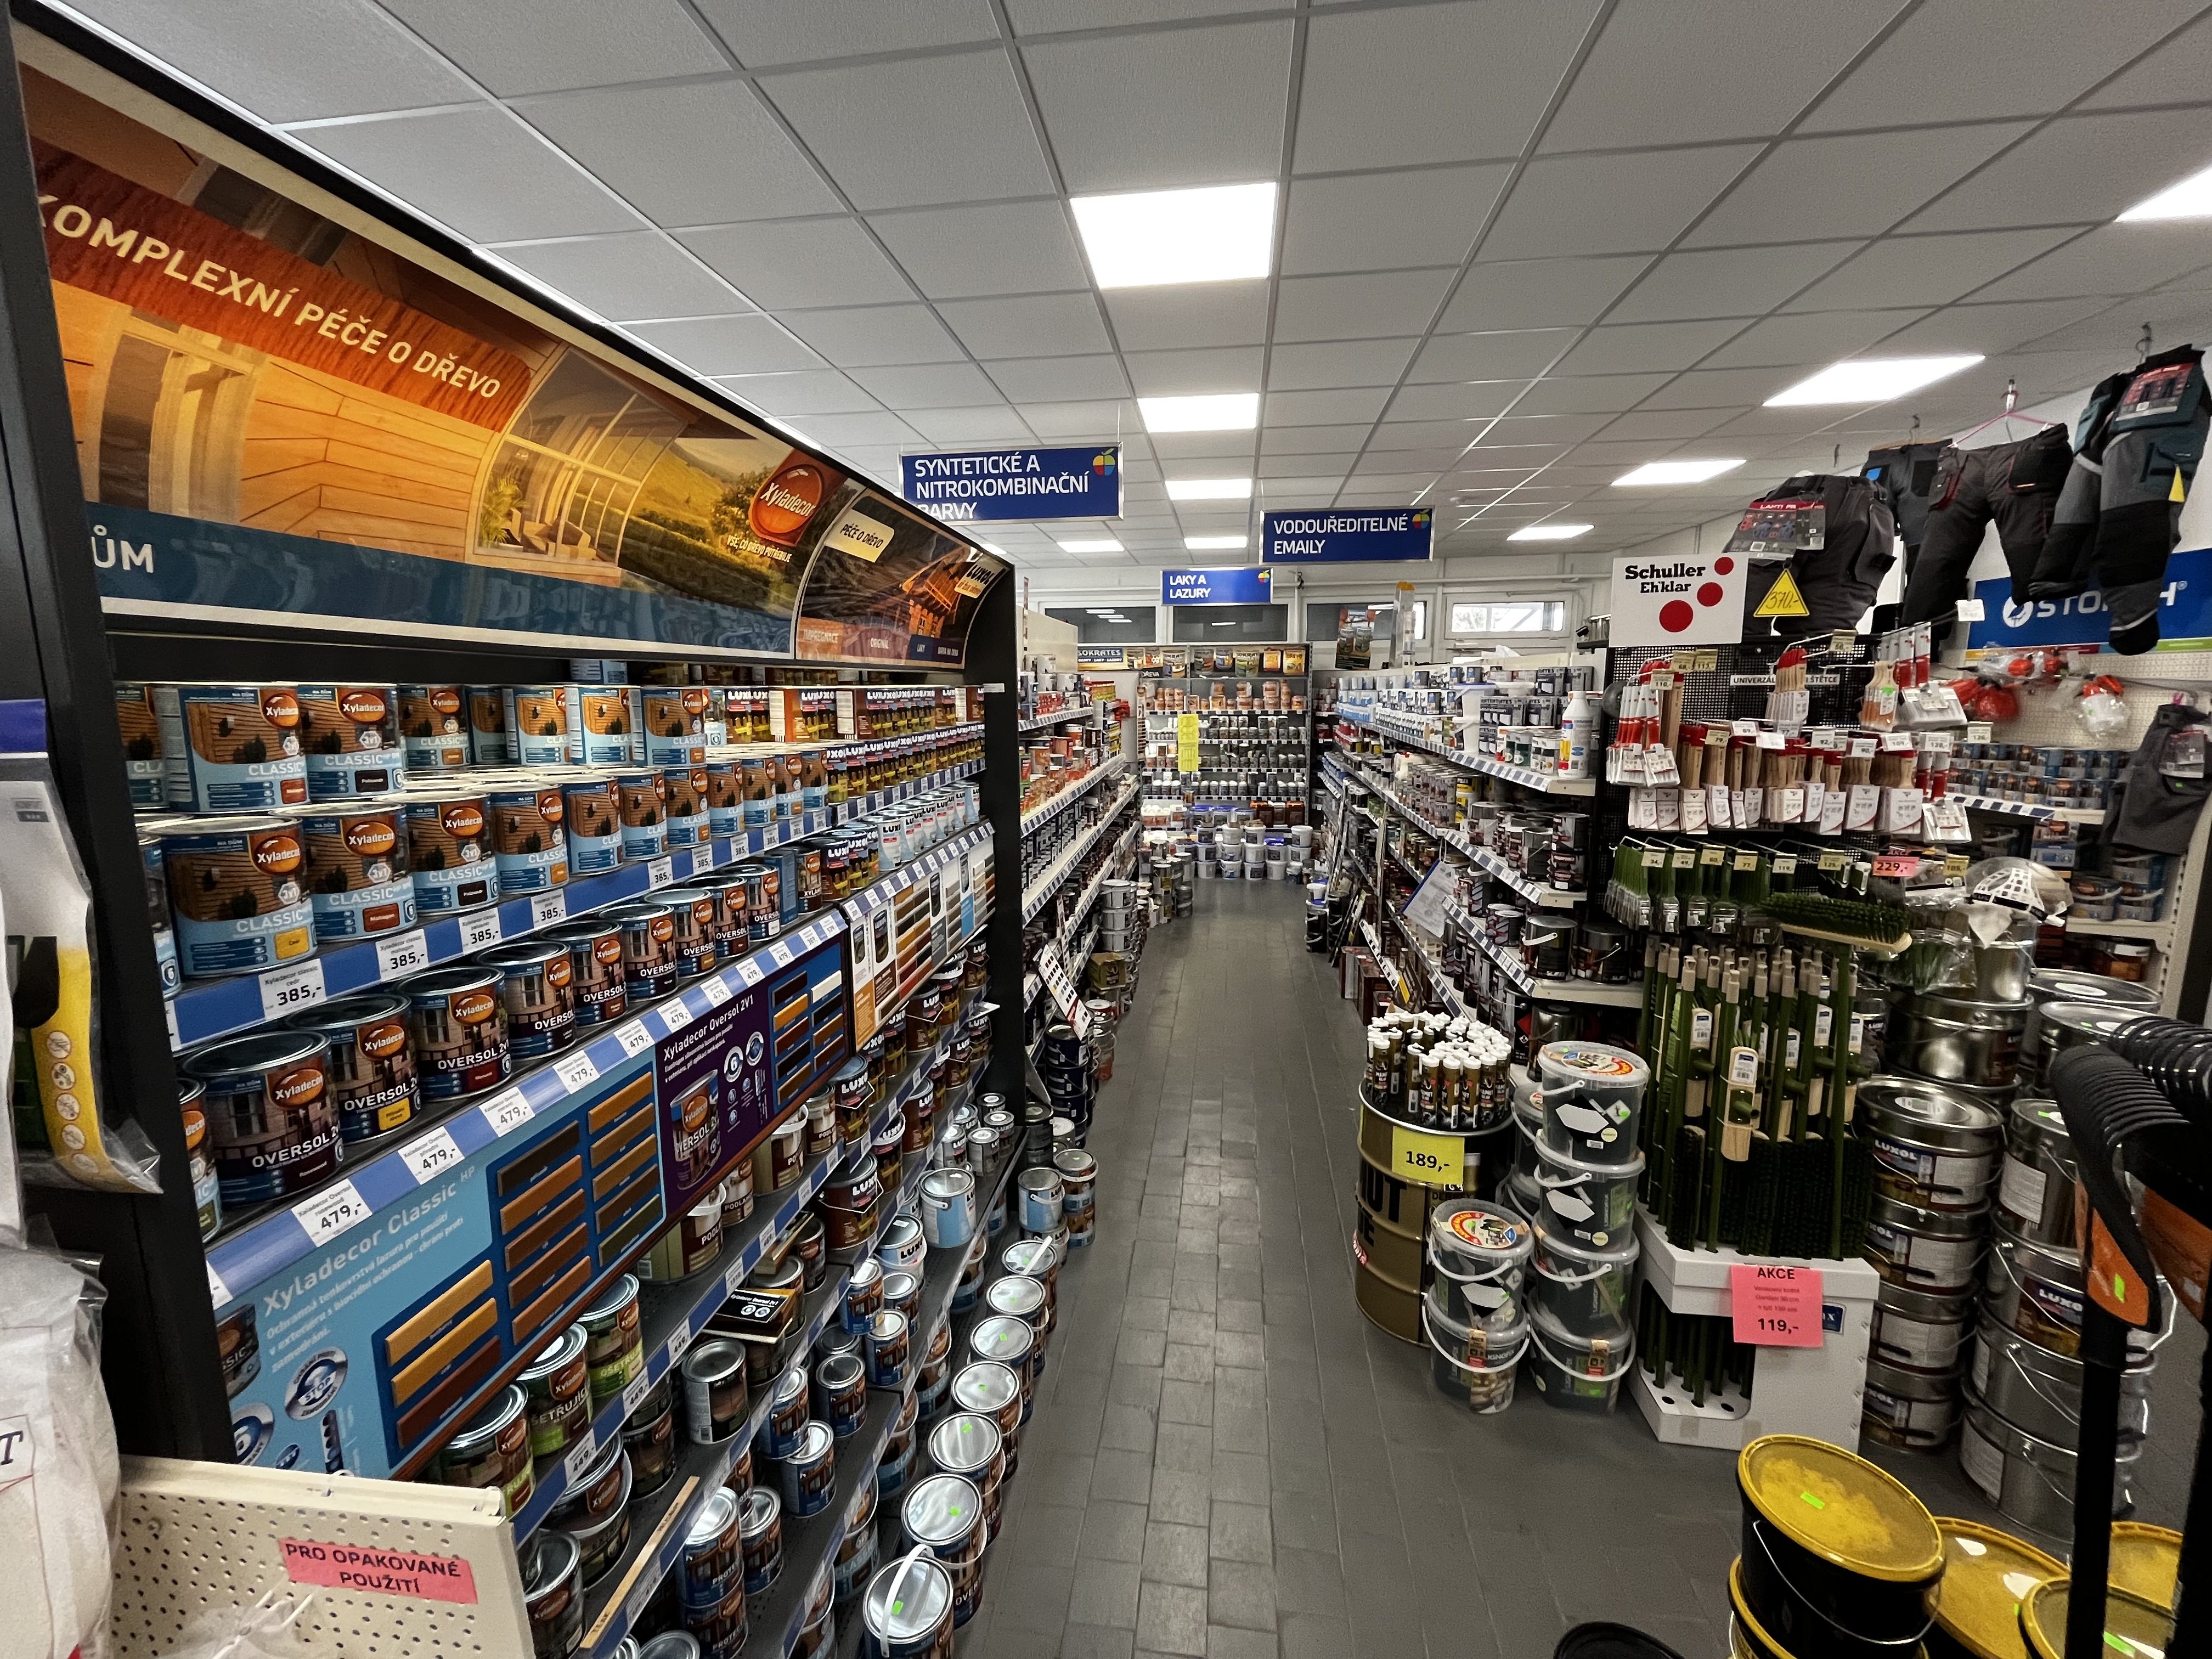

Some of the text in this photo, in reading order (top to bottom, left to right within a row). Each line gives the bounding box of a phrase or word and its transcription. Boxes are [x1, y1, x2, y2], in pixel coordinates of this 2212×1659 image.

[295, 303, 388, 353] PÉČE
[388, 341, 411, 364] O
[414, 350, 501, 399] DŘEVO
[915, 452, 1041, 478] SYNTETICKÉ A
[916, 471, 1089, 499] NITROKOMBINAČNÍ
[760, 482, 817, 517] Xyladecor
[1273, 513, 1408, 535] VODOUŘEDITELNÉ
[839, 522, 884, 549] PÉČE O DŘEVO
[1273, 539, 1326, 555] EMAILY
[1169, 574, 1206, 586] LAKY A
[1624, 563, 1706, 580] Schuller
[1169, 587, 1212, 599] LAZURY
[2036, 581, 2177, 618] STOH
[1733, 676, 1808, 684] UNIVERZÁLÍ
[248, 761, 303, 776] CLASSIC
[324, 754, 383, 766] CLASSIC
[445, 816, 483, 828] Xyladecor
[348, 832, 395, 846] Xyladecor
[257, 848, 301, 864] Xyladecor
[428, 867, 483, 882] CLASSIC
[1876, 861, 1908, 873] 229,-
[654, 872, 672, 884] 385,-
[329, 887, 394, 906] CLASSIC
[235, 909, 304, 933] CLASSIC
[540, 907, 565, 922] 385,-
[470, 928, 499, 945] 385,-
[390, 951, 425, 970] 385,-
[640, 960, 675, 978] OVERSOL
[264, 964, 318, 985] Xyladecor classic
[276, 984, 322, 1007] 385,-
[583, 984, 624, 1003] OVERSOL
[455, 1000, 494, 1017] Xyladecor
[670, 1011, 689, 1025] 479,-
[534, 1009, 575, 1031] OVERSOL
[663, 1025, 708, 1062] Xyladecor
[709, 1003, 740, 1031] Oversol
[740, 994, 754, 1012] 2V1
[364, 1030, 406, 1052] Xyladecor
[629, 1035, 649, 1048] 479,-
[437, 1048, 498, 1071] OVERSOL
[730, 1056, 737, 1072] 6
[570, 1068, 594, 1084] 479,-
[275, 1074, 324, 1101] Xyladecor
[344, 1081, 410, 1111] OVERSOL
[500, 1105, 529, 1125] 479,-
[251, 1130, 330, 1168] OVERSOL
[422, 1146, 457, 1171] 479,-
[1875, 1139, 1917, 1160] LUXOL
[1405, 1150, 1449, 1172] 189,-
[460, 1165, 476, 1183] HP
[320, 1201, 363, 1229] 479,-
[263, 1181, 456, 1318] Xyladecor Classic
[1757, 1267, 1796, 1280] AKCE
[2039, 1287, 2084, 1312] LUXO
[1758, 1318, 1799, 1335] 119,-
[305, 1377, 331, 1401] STOP
[286, 1542, 461, 1578] PRO OPAKOVANÉ
[340, 1570, 421, 1594] POUŽITÍ
